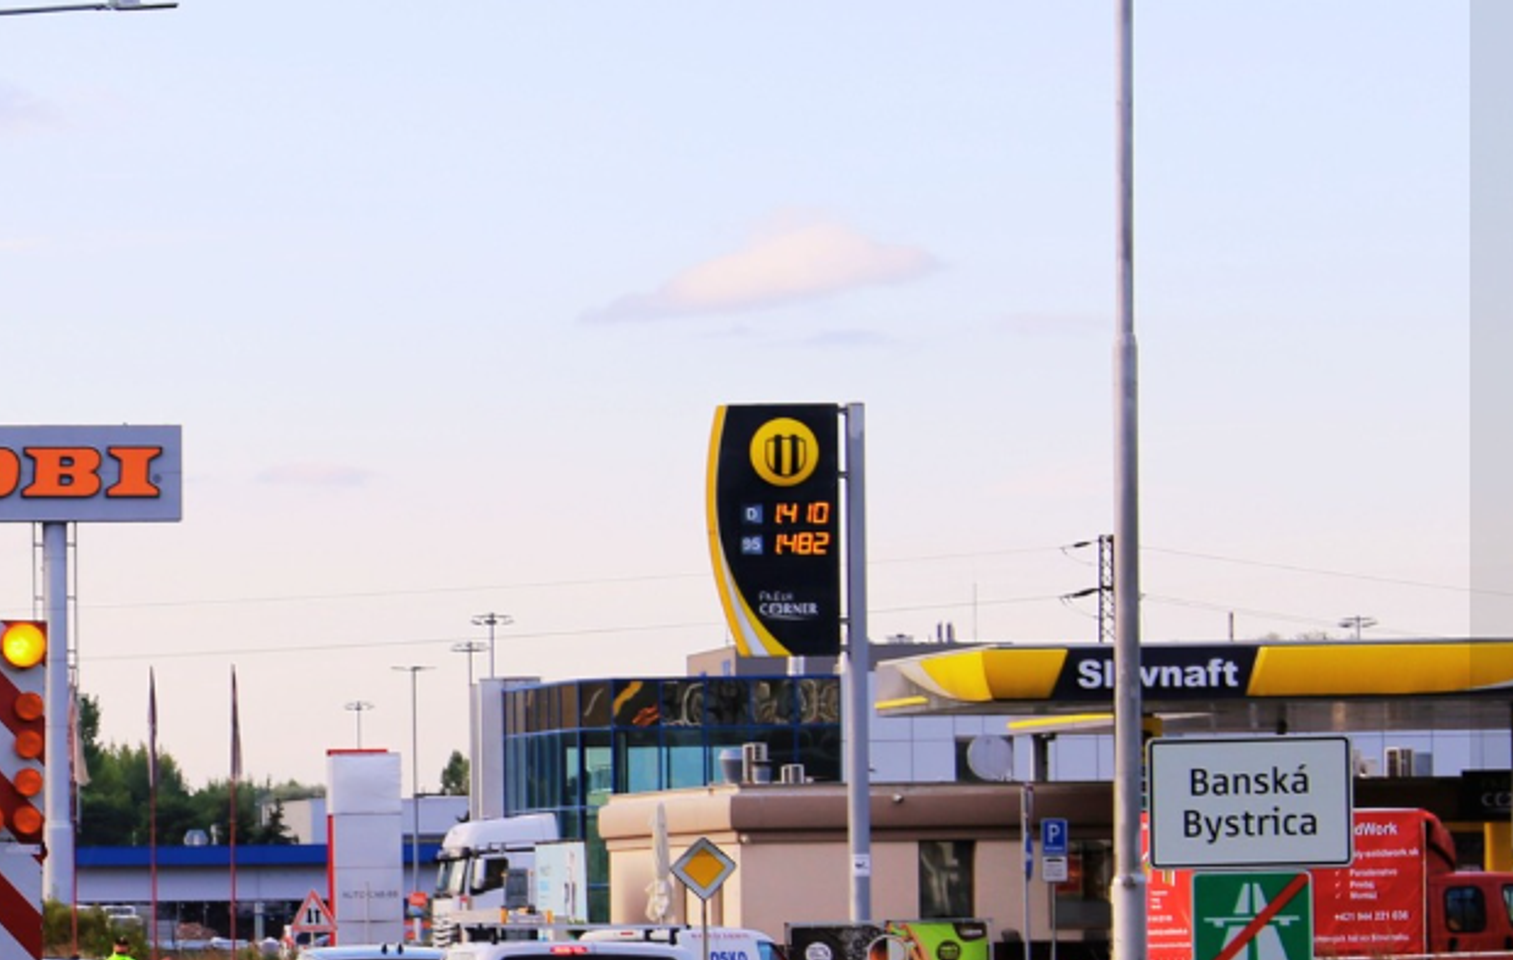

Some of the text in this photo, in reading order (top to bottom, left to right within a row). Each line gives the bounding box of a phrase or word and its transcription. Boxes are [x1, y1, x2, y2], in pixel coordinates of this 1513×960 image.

[746, 507, 758, 520] D
[742, 532, 830, 555] 95 1482
[759, 603, 819, 615] CORNER
[1077, 658, 1239, 689] Slvnaft
[1190, 764, 1309, 796] Banská
[1183, 806, 1318, 844] Bystrica
